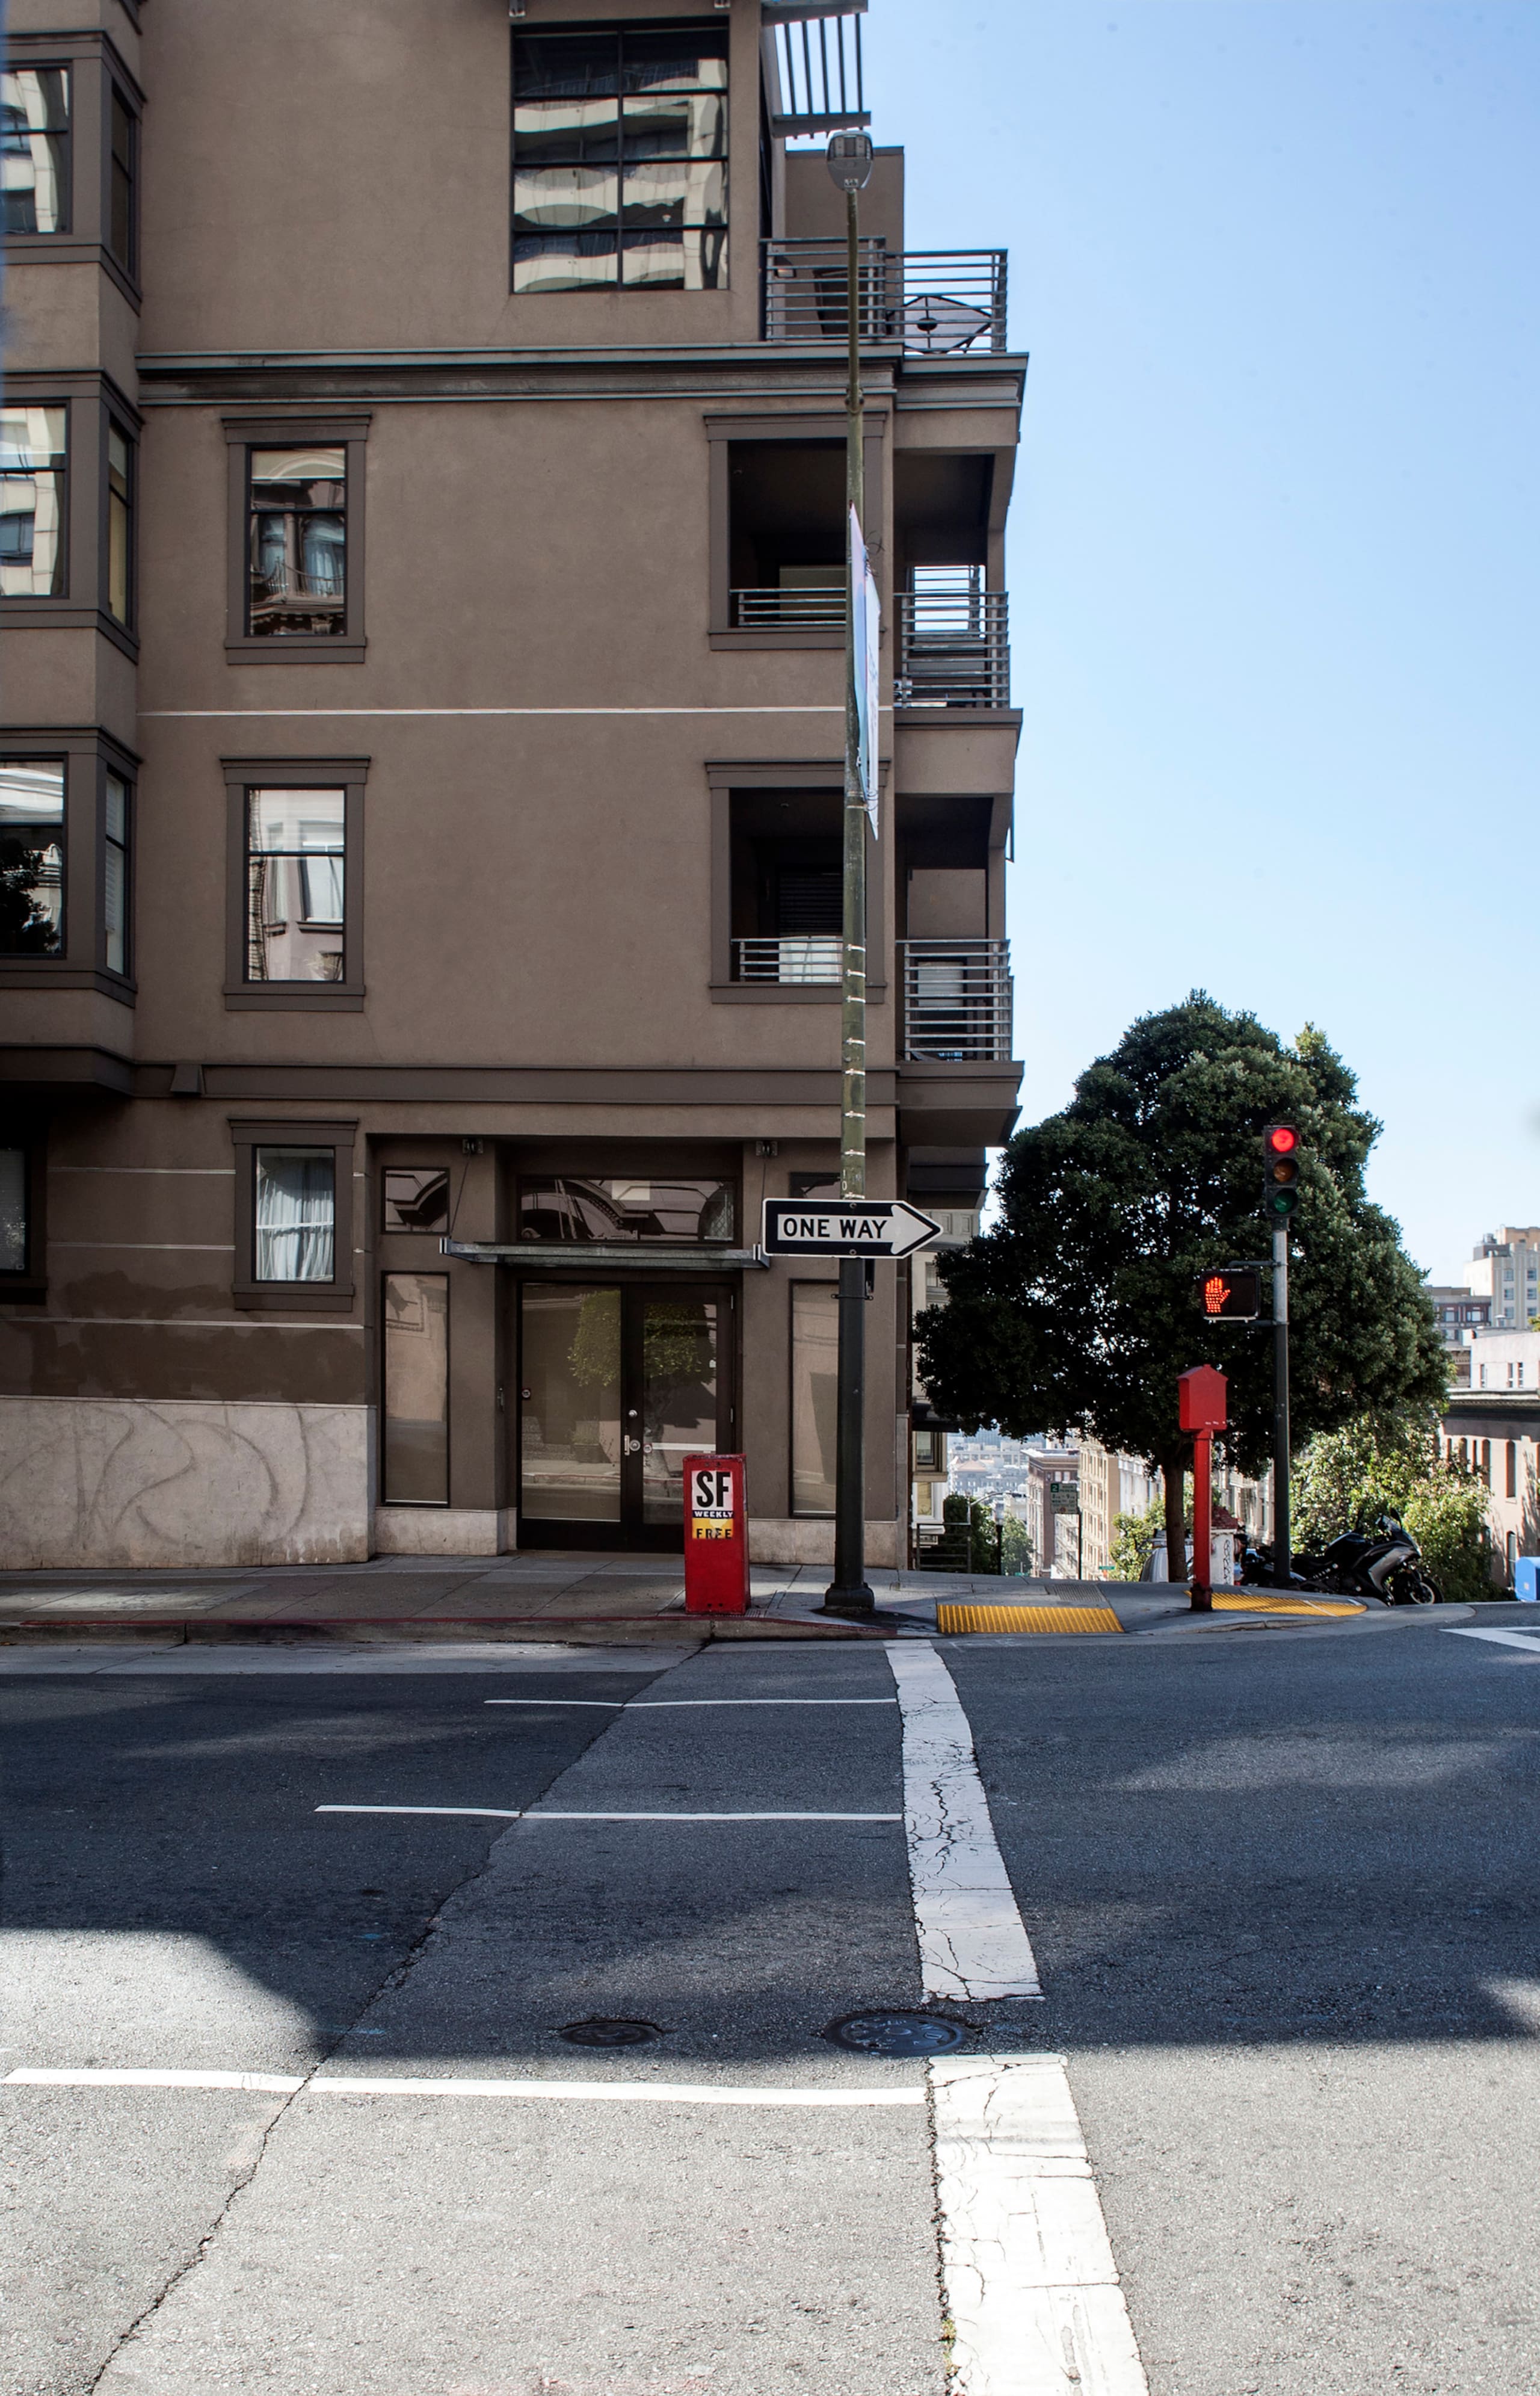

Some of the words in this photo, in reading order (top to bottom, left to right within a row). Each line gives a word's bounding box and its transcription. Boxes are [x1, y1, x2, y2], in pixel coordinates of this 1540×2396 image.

[784, 1218, 830, 1237] ONE
[840, 1220, 887, 1238] WAY
[696, 1471, 730, 1507] SF
[696, 1528, 732, 1539] FREE
